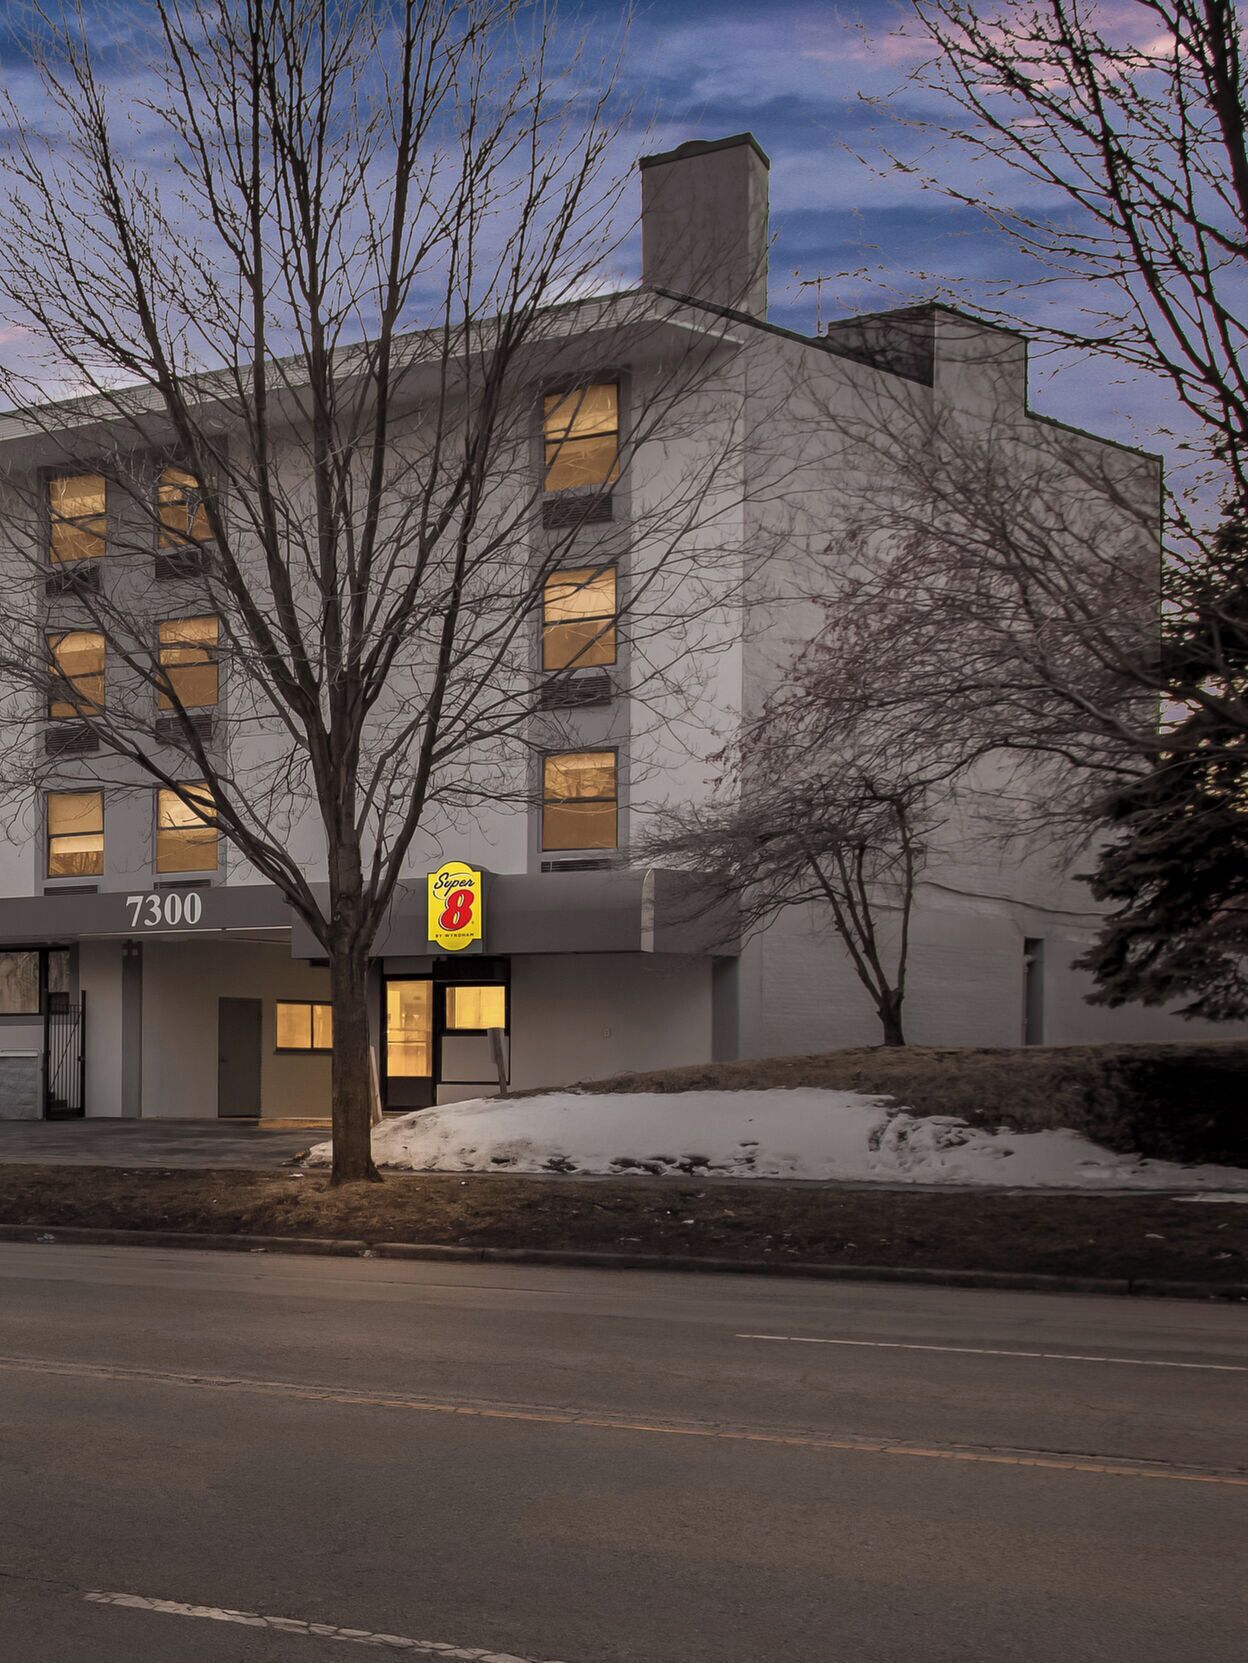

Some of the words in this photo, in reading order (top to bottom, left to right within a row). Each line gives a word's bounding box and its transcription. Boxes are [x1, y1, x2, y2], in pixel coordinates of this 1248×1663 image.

[434, 872, 475, 897] Super
[126, 892, 202, 927] 7300
[438, 889, 475, 931] 8
